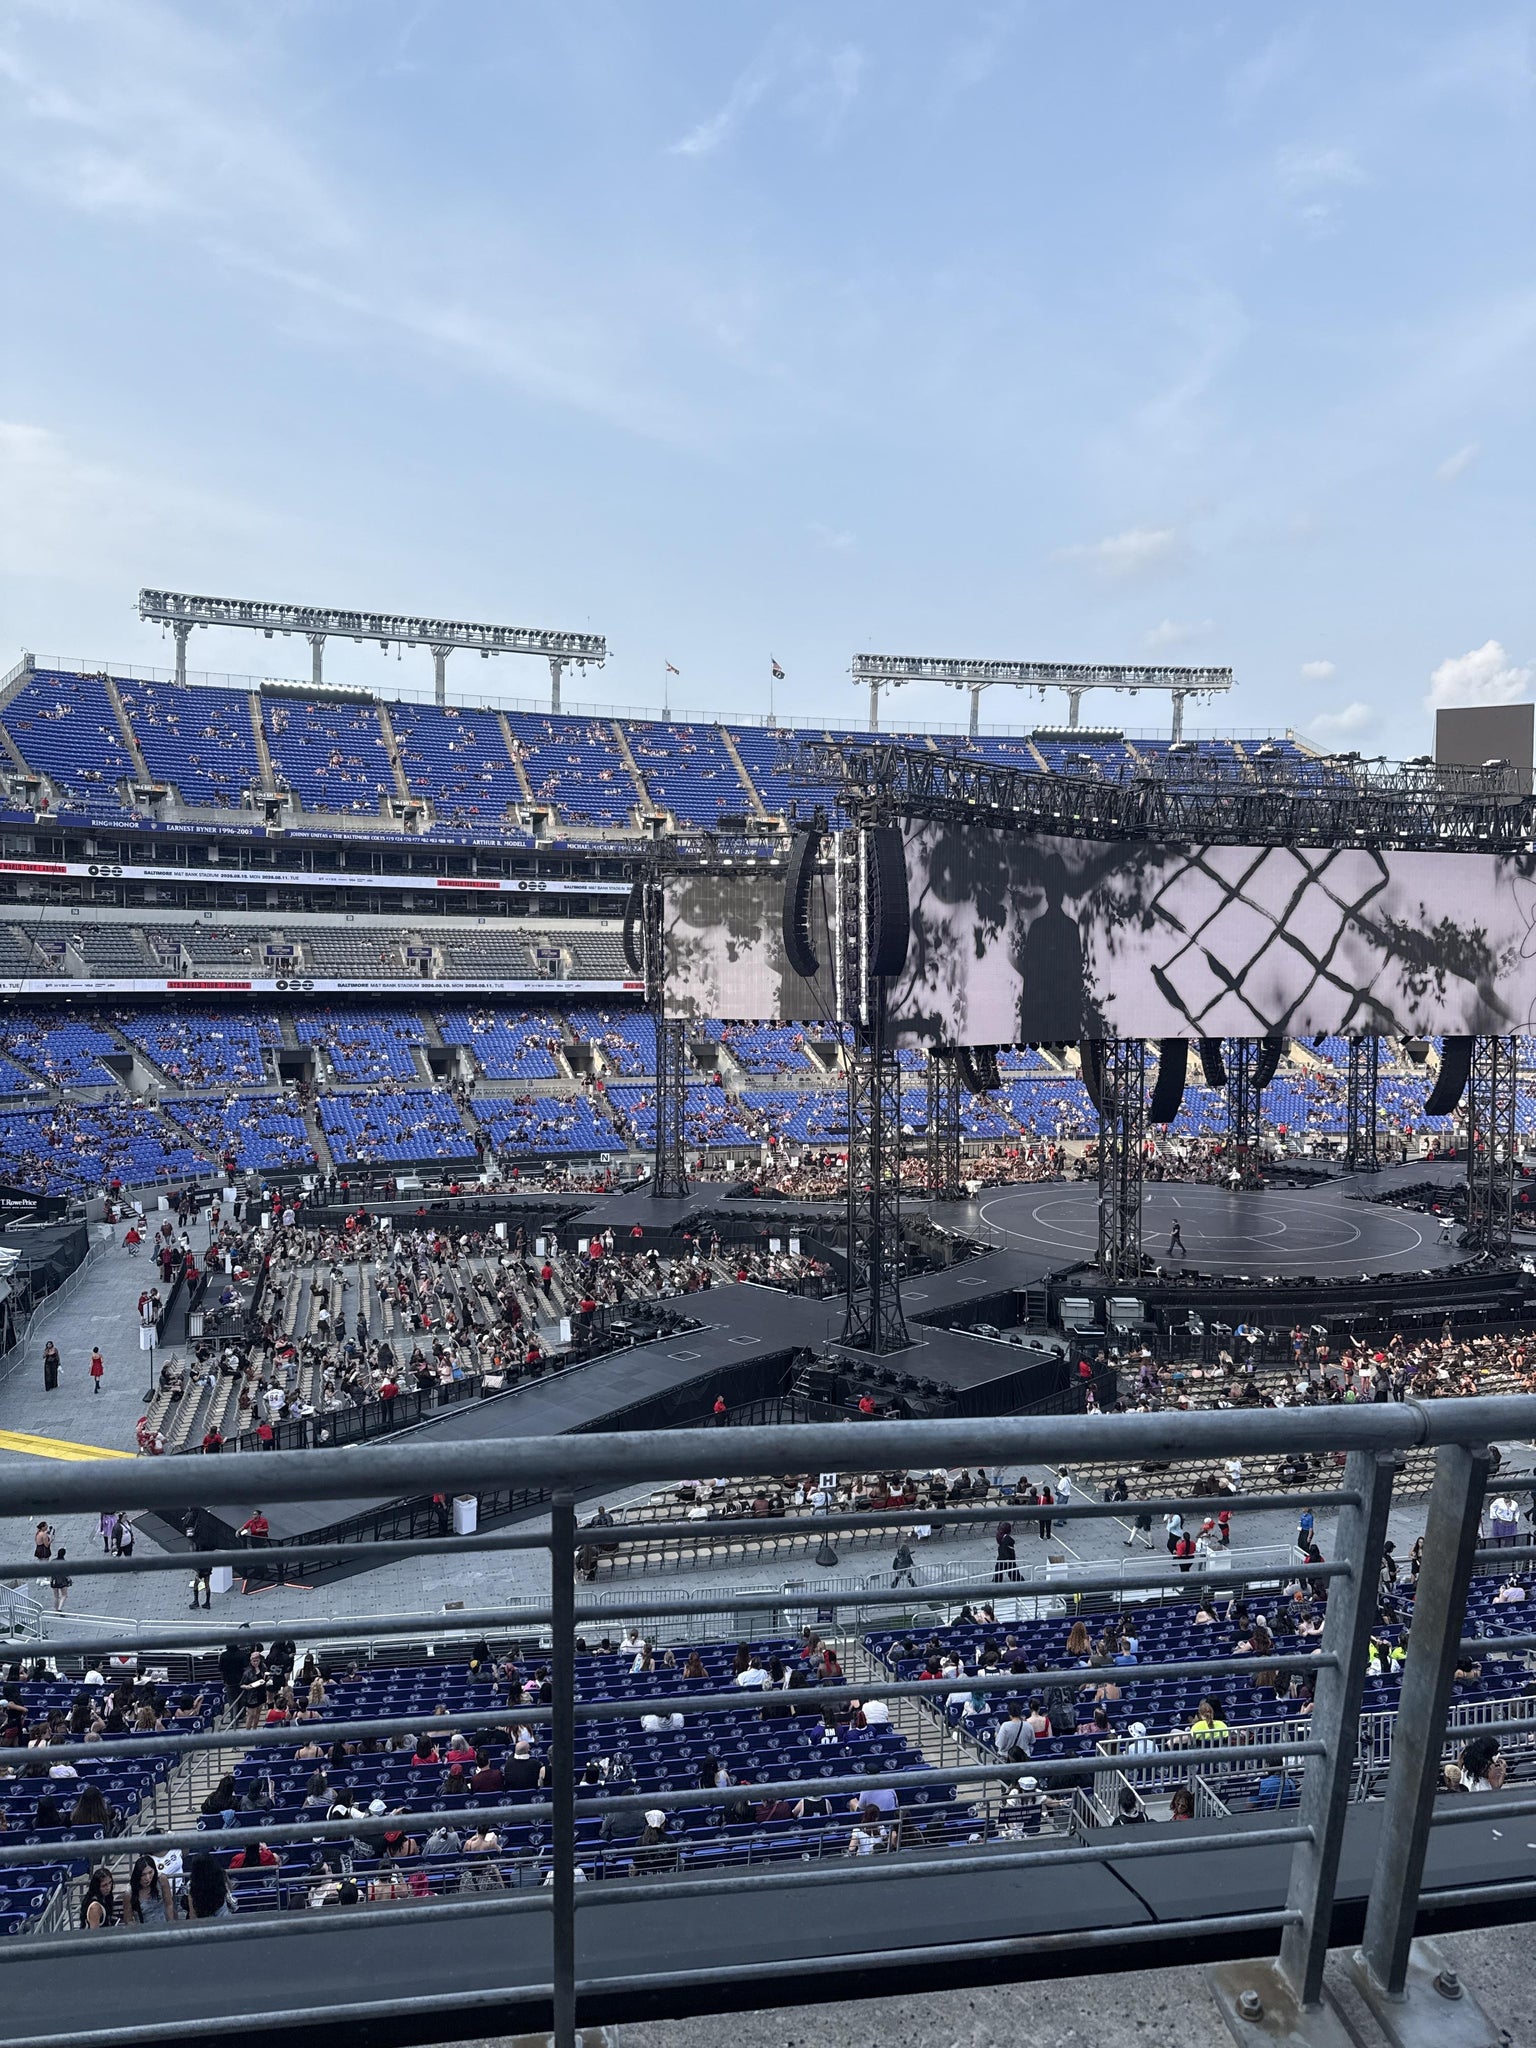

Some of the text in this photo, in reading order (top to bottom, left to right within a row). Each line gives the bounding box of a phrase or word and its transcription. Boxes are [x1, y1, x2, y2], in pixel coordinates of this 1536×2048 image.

[823, 1475, 833, 1486] H
[270, 1664, 284, 1675] 95
[825, 1728, 835, 1736] RM
